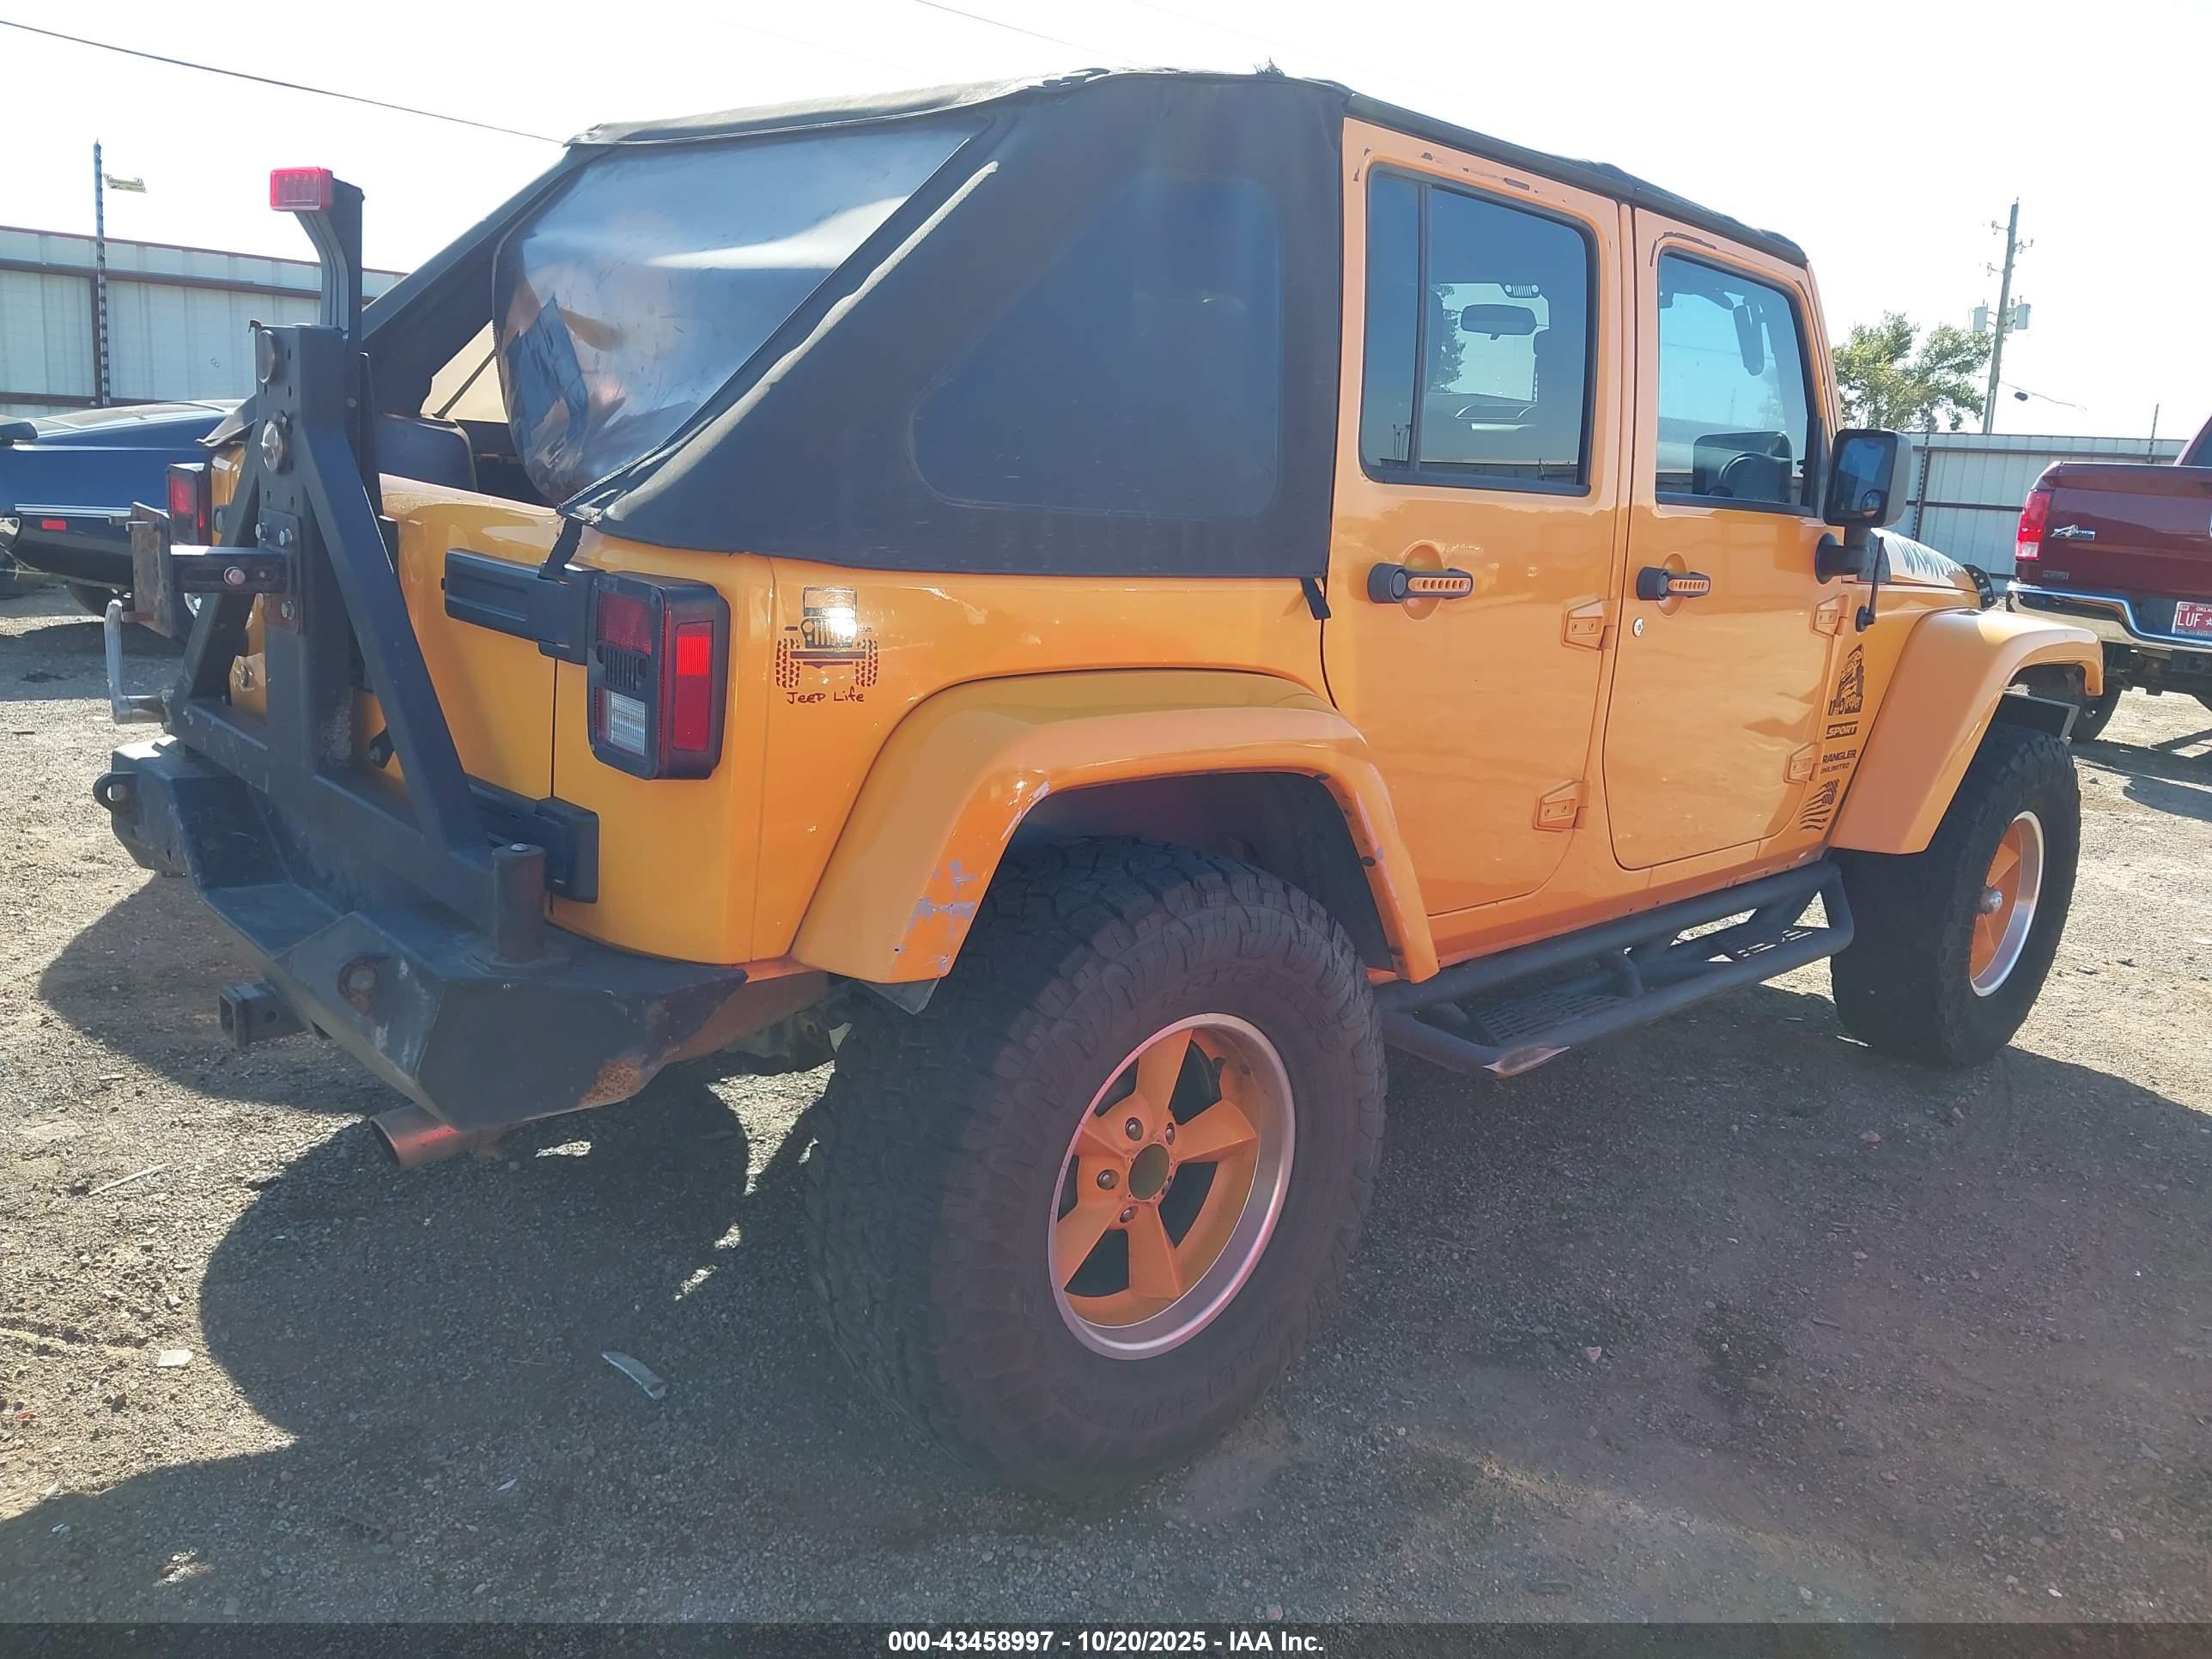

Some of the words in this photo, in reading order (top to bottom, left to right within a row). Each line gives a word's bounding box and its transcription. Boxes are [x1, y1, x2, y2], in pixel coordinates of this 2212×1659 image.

[2177, 611, 2203, 628] LUF
[834, 685, 866, 702] Life
[1826, 724, 1856, 737] SPORT
